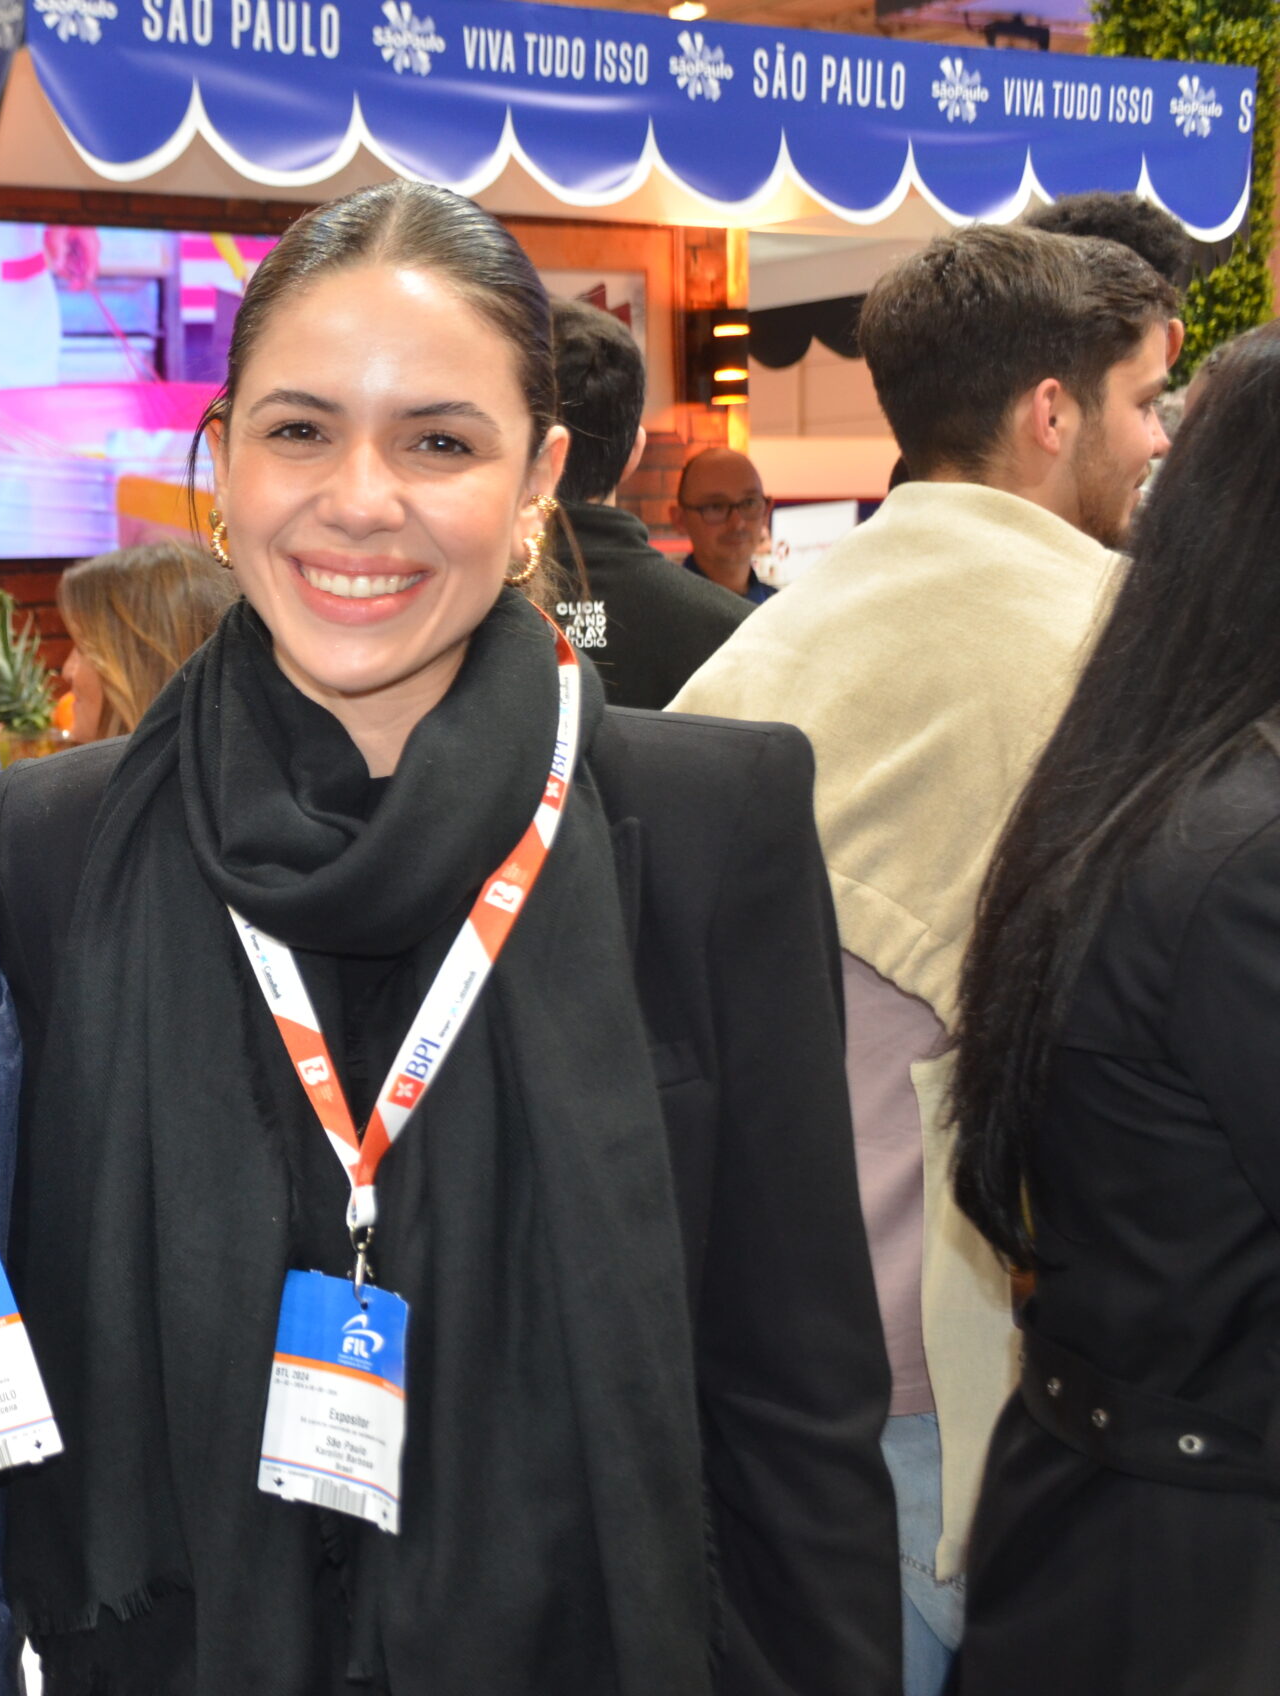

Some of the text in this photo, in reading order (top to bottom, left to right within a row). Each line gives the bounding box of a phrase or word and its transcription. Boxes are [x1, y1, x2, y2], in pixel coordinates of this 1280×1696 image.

[231, 0, 340, 59] PAULO
[463, 25, 649, 86] VIVA TUDO ISSO
[753, 42, 906, 111] SÃO PAULO
[1003, 77, 1153, 125] VIVA TUDO ISSO
[556, 600, 605, 615] CLICK
[565, 625, 607, 638] PLAY
[573, 613, 607, 627] AND
[569, 637, 608, 648] TUDIO
[404, 1036, 441, 1080] BPI
[342, 1336, 371, 1359] FIL
[329, 1407, 370, 1429] Expositor
